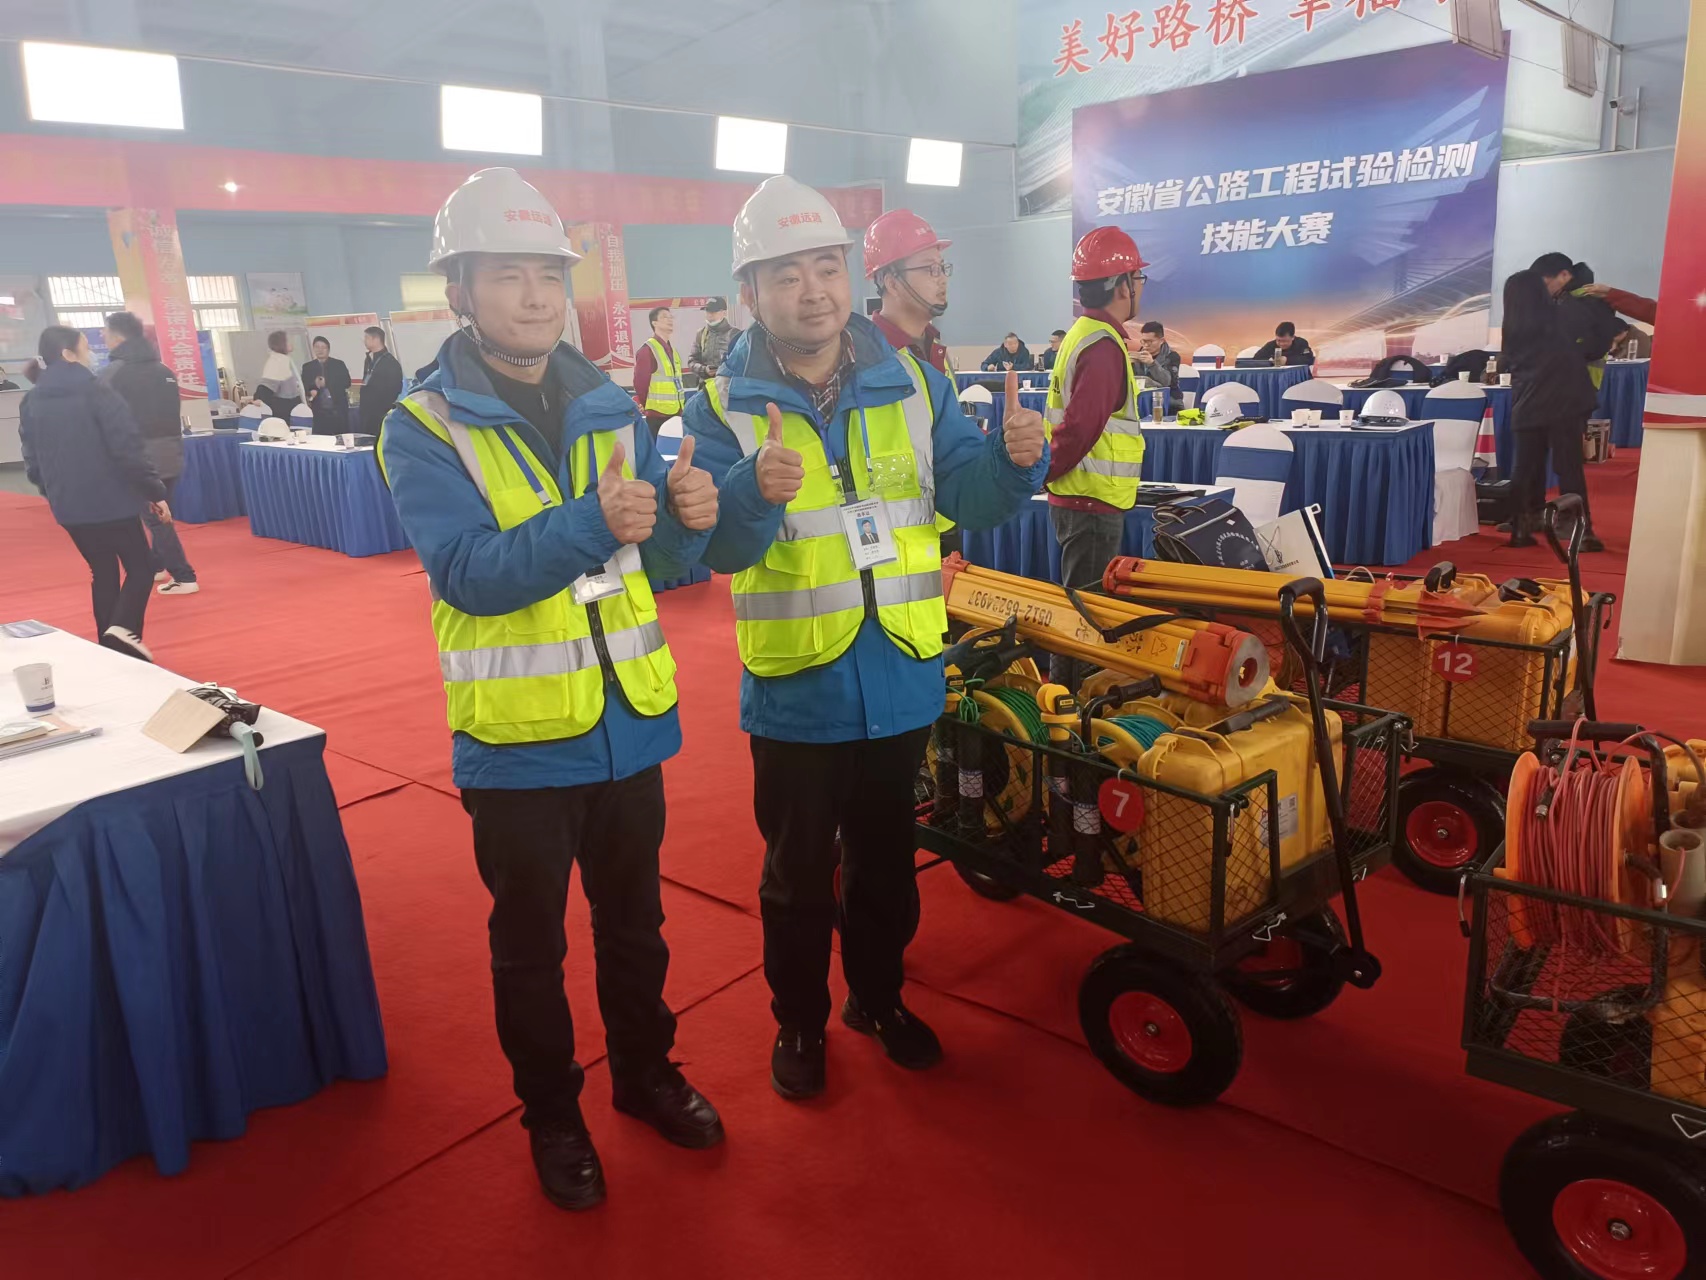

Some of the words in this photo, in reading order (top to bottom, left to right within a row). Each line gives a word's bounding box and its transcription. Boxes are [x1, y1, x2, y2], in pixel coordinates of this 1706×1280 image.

[1053, 0, 1259, 77] 美好路桥
[1096, 141, 1478, 217] 安徽省公路工程试验检测
[1200, 212, 1334, 255] 技能大赛
[612, 301, 631, 358] 永不退缩
[1437, 651, 1473, 675] 12
[1112, 789, 1130, 817] 7
